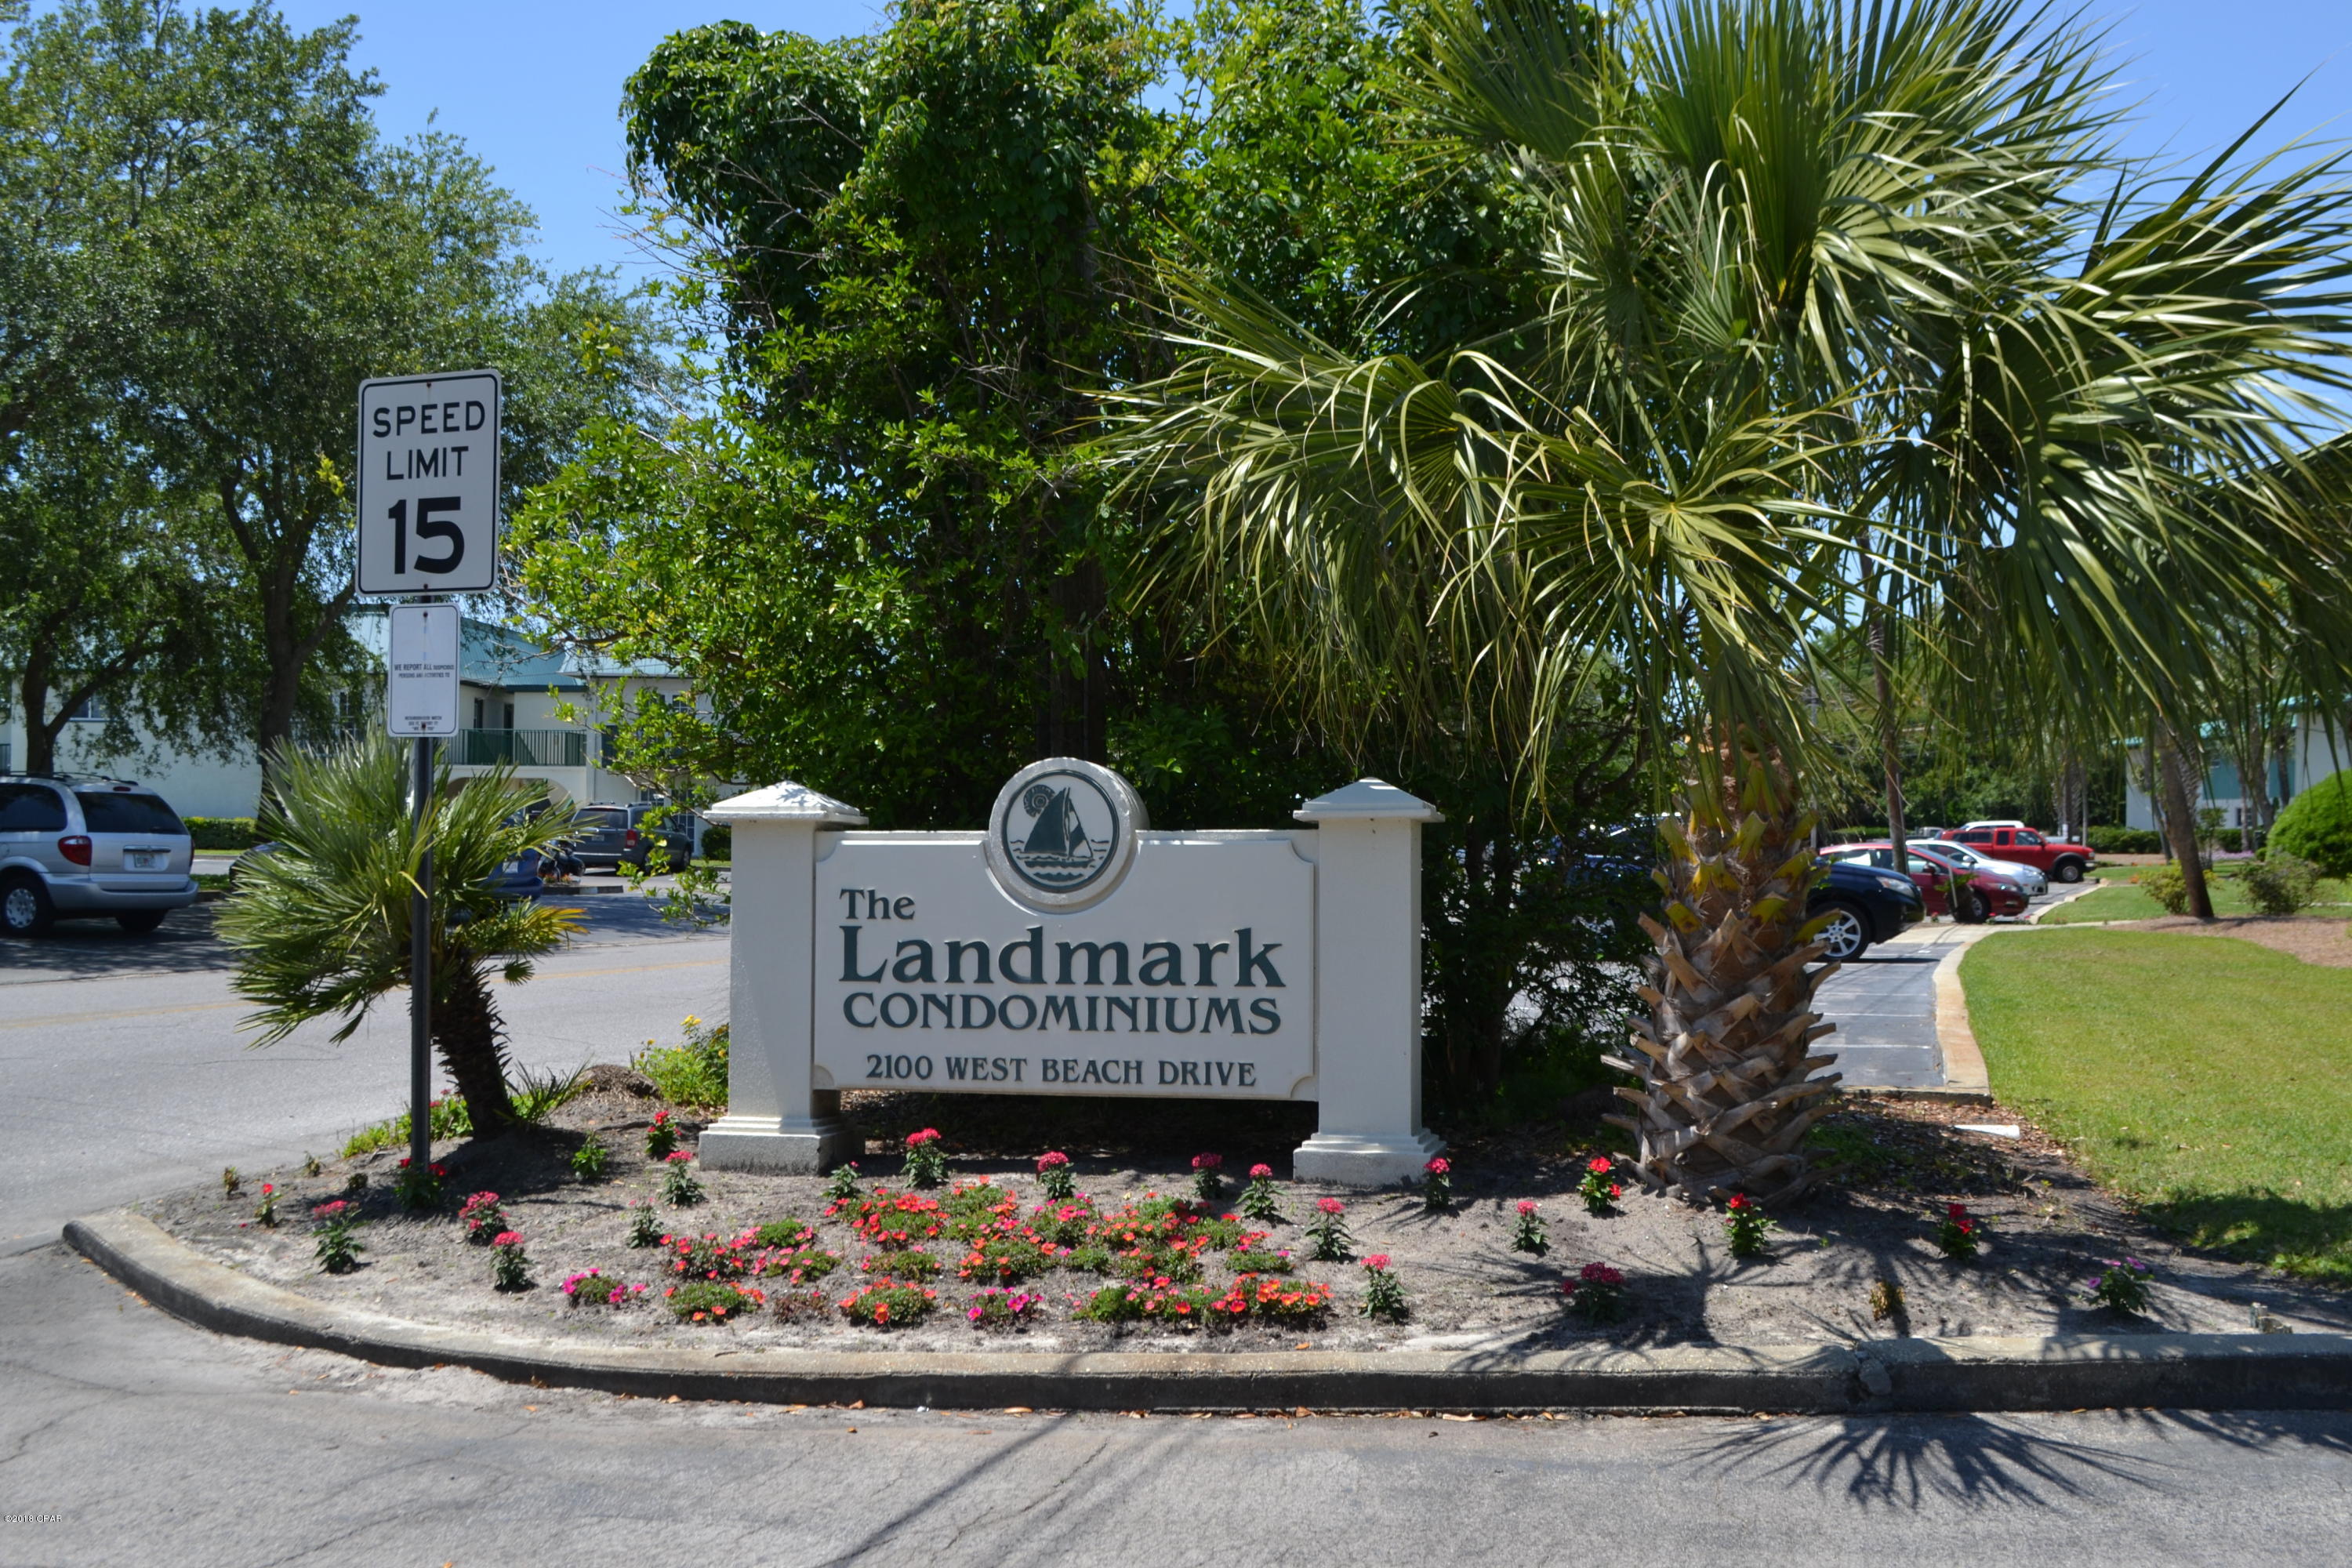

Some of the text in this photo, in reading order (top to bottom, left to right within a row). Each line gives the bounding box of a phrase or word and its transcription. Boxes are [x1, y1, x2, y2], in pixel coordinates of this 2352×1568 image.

[372, 400, 485, 438] SPEED
[387, 445, 469, 481] LIMIT
[387, 495, 465, 575] 15
[840, 888, 915, 920] The
[839, 926, 1286, 988] Landmark
[844, 992, 1281, 1035] CONDOMINIUMS
[866, 1054, 1256, 1087] 2100 WEST BEACH DRIVE
